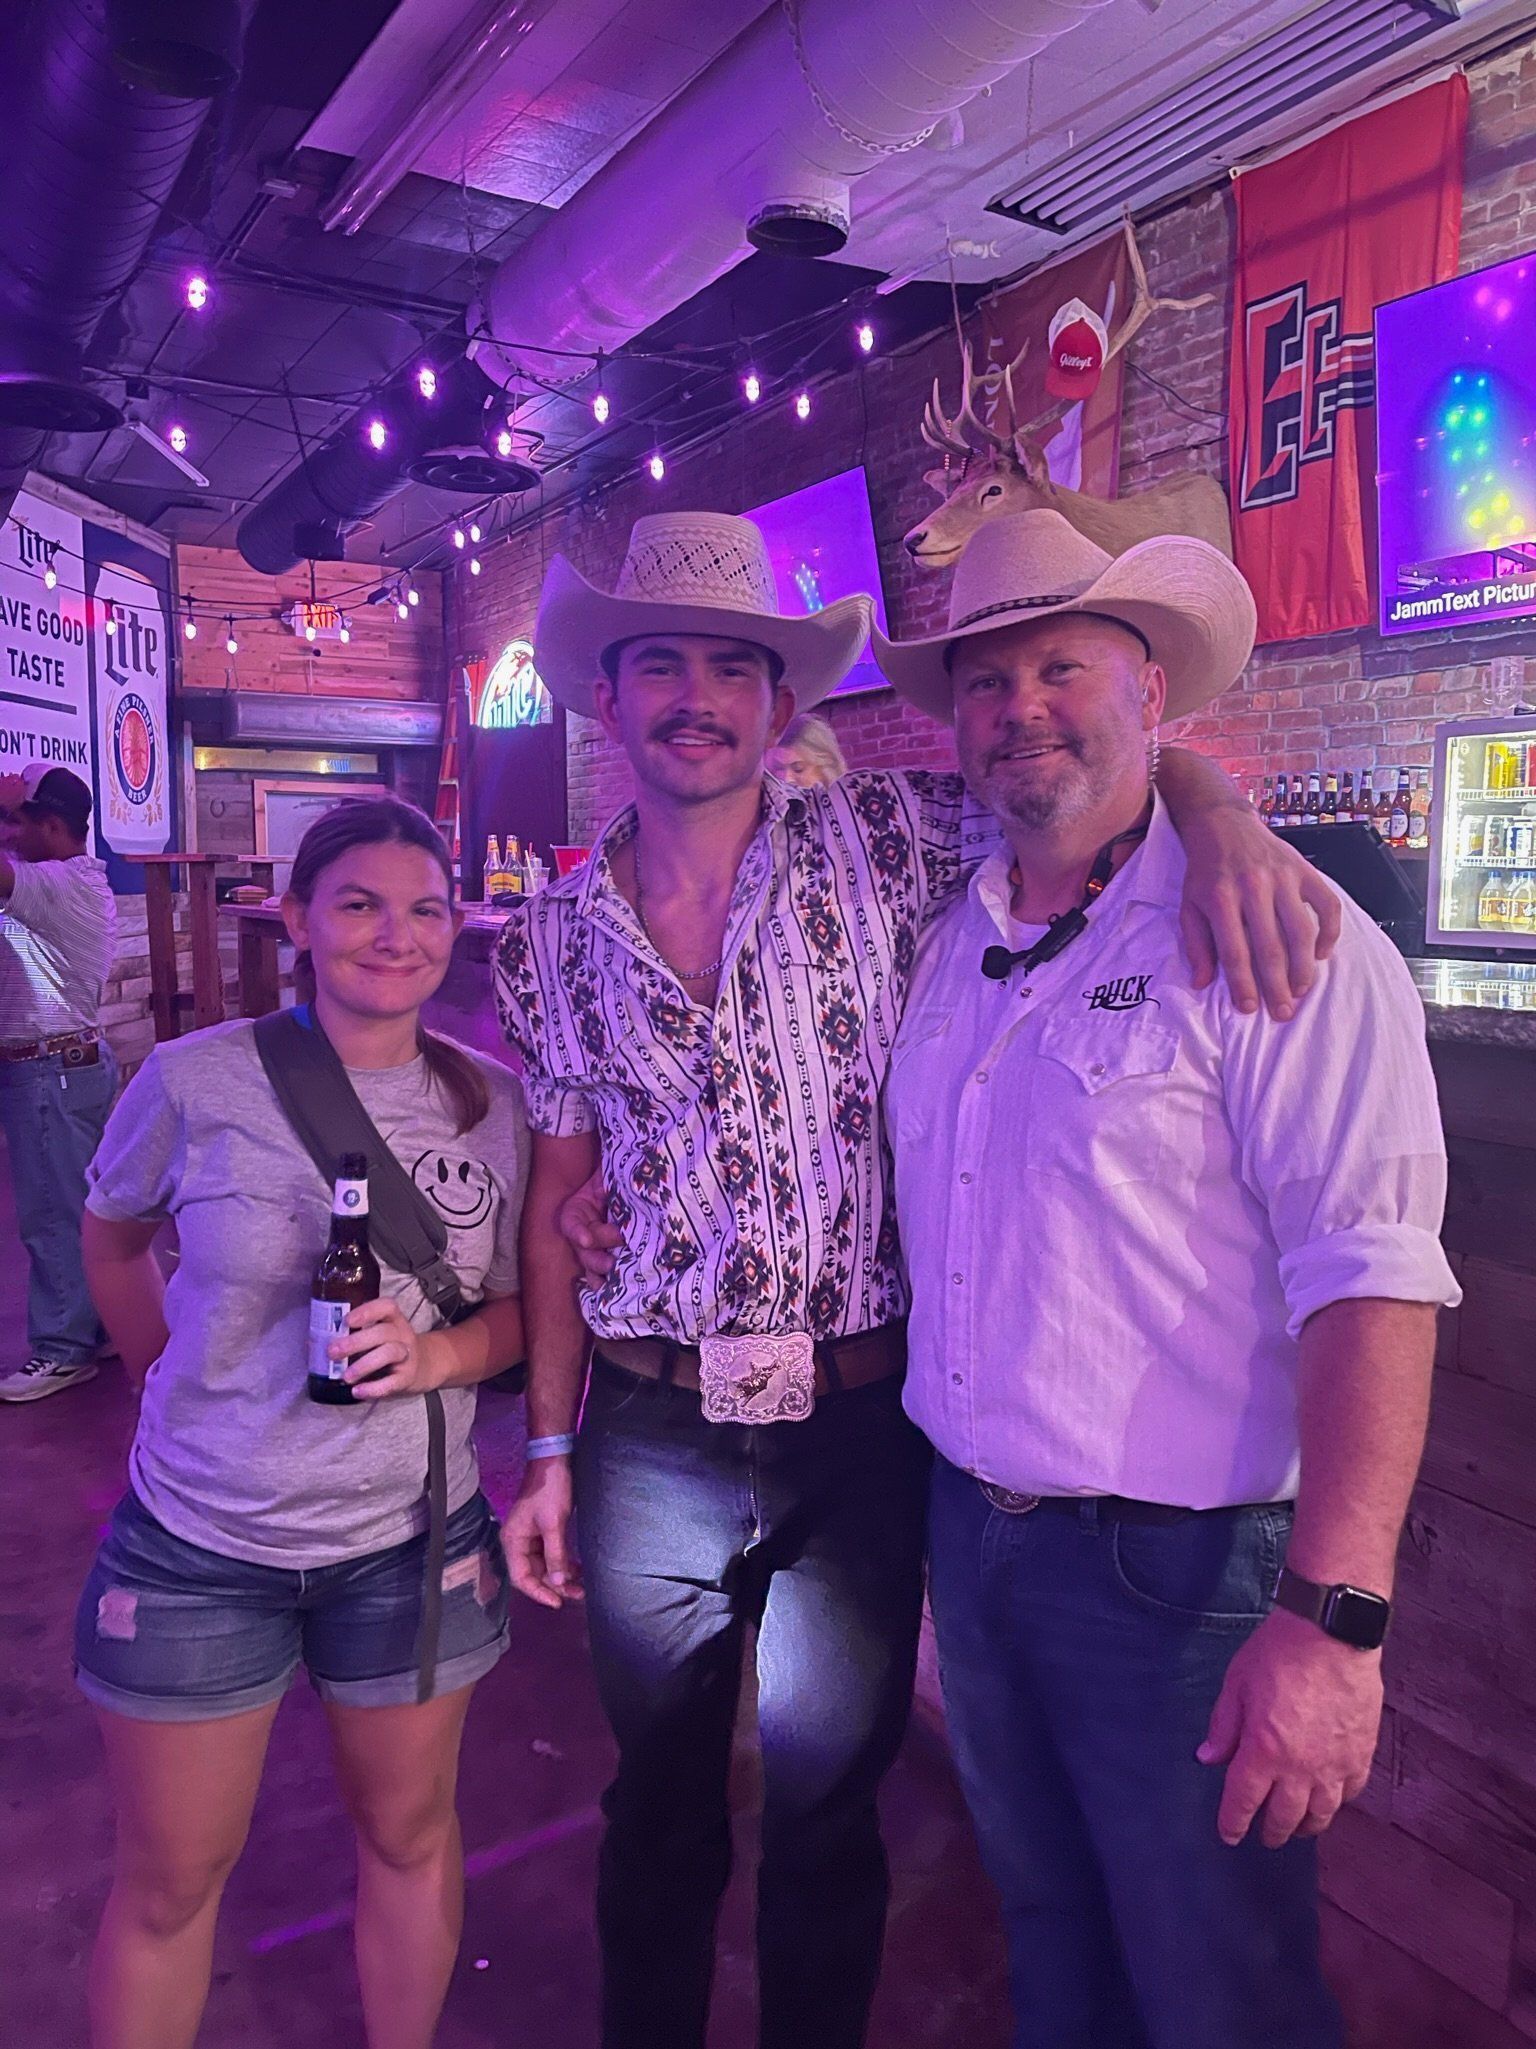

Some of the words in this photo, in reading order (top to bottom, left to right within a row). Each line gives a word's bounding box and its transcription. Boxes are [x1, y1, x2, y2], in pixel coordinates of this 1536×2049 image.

[1390, 589, 1480, 621] JammText
[37, 607, 84, 647] GOOD
[104, 599, 157, 686] Lite
[7, 647, 65, 688] TASTE
[116, 697, 130, 725] FINE
[41, 735, 88, 765] DRINK
[115, 729, 120, 739] A
[127, 789, 147, 802] BEER
[1084, 974, 1155, 1010] BUCK
